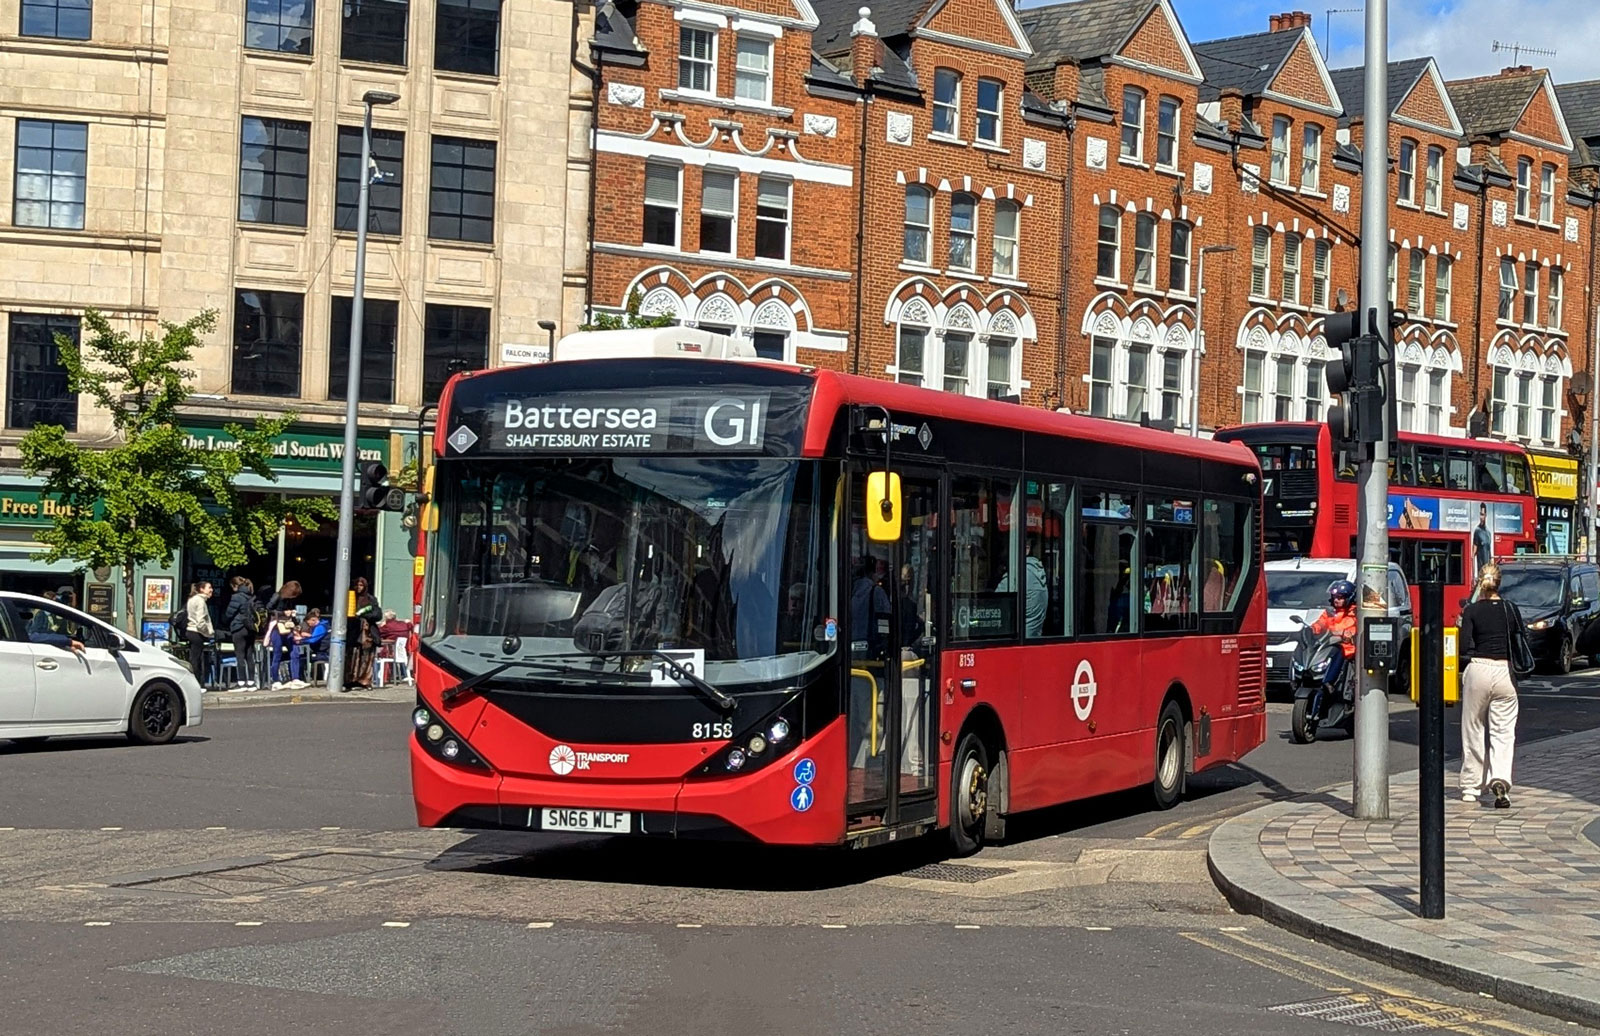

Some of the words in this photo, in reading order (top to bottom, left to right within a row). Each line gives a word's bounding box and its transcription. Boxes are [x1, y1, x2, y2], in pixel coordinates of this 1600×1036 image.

[506, 349, 531, 357] FALCON
[504, 399, 657, 429] Battersea
[505, 433, 599, 448] SHAFTESBURY
[601, 434, 651, 448] ESTATE
[290, 440, 328, 458] South
[1, 498, 38, 514] Free
[959, 653, 975, 667] 8158
[692, 722, 733, 738] 8158
[575, 752, 630, 763] TRANSPORT
[576, 761, 591, 770] UK
[548, 809, 589, 828] SN66
[592, 812, 624, 829] WLF
